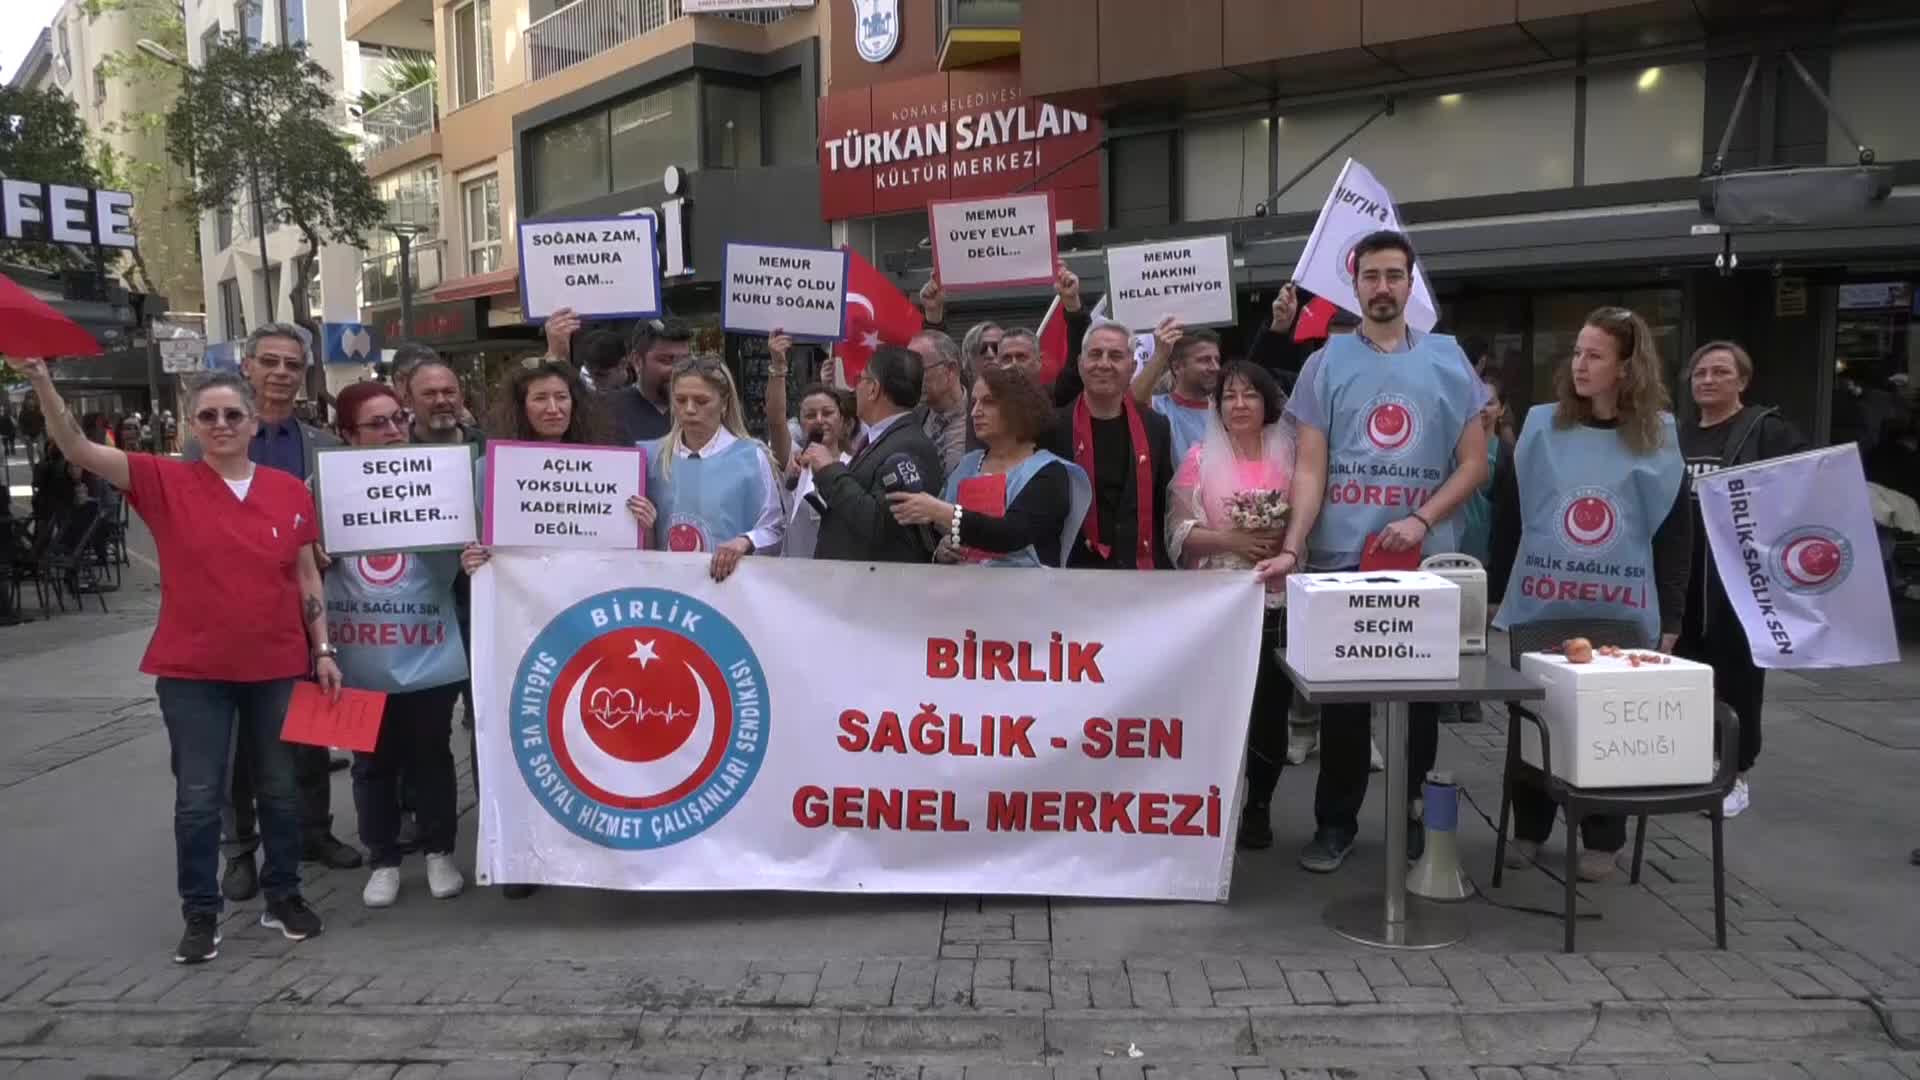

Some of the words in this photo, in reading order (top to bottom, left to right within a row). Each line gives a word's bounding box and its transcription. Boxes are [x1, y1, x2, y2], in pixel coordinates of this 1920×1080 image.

[892, 104, 937, 121] KONAK
[825, 121, 947, 170] TÜRKAN
[956, 103, 1088, 150] SAYLAN
[876, 164, 947, 189] KÜLTÜR
[953, 145, 1041, 177] MERKEZİ
[965, 207, 1016, 222] MEMUR
[532, 231, 598, 246] SOĞANA
[602, 229, 641, 244] ZAM,
[949, 228, 986, 242] ÜVEY
[991, 224, 1035, 238] EVLAT
[553, 251, 622, 266] MEMURA
[759, 256, 811, 270] MEMUR
[1144, 248, 1191, 263] MEMUR
[565, 273, 614, 287] GAM...
[733, 273, 793, 290] MUHTAÇ
[797, 279, 836, 291] OLDU
[1119, 287, 1160, 300] HELAL
[1164, 280, 1222, 295] ETMİYOR
[732, 292, 771, 305] KURU
[776, 295, 835, 310] SOĞANA
[362, 456, 432, 476] SEÇİMİ
[543, 458, 593, 474] AÇLIK
[1370, 463, 1420, 478] SAĞLIK
[1423, 468, 1440, 480] SEN
[366, 481, 432, 500] GEÇİM
[516, 479, 617, 494] YOKSULLUK
[342, 507, 459, 526] BELİRLER...
[520, 501, 613, 515] KADERİMİZ
[534, 520, 598, 536] DEĞİL...
[1566, 559, 1621, 577] SAĞLIK
[1727, 478, 1758, 545] BİRLİK
[1743, 544, 1776, 616] SAĞLIK
[1766, 619, 1794, 655] SEN
[1520, 573, 1646, 609] GÖREVLİ
[362, 599, 416, 614] SAĞLIK
[1349, 594, 1421, 608] MEMUR
[590, 597, 702, 633] BİRLİK
[327, 618, 445, 646] GÖREVLİ
[1353, 617, 1414, 636] SEÇİM
[926, 629, 1105, 683] BİRLİK
[1335, 641, 1431, 659] SANDIĞI...
[521, 651, 558, 718] SAĞLIK
[728, 658, 761, 753] SENDİKASI
[521, 724, 543, 749] VE
[836, 702, 1036, 759] SAĞLIK
[1081, 717, 1183, 760] SEN
[529, 753, 574, 815] SOSYAL
[651, 756, 750, 842] ÇALIŞANLARI
[792, 784, 970, 832] GENEL
[985, 784, 1222, 838] MERKEZİ
[577, 804, 643, 839] HİZMET
